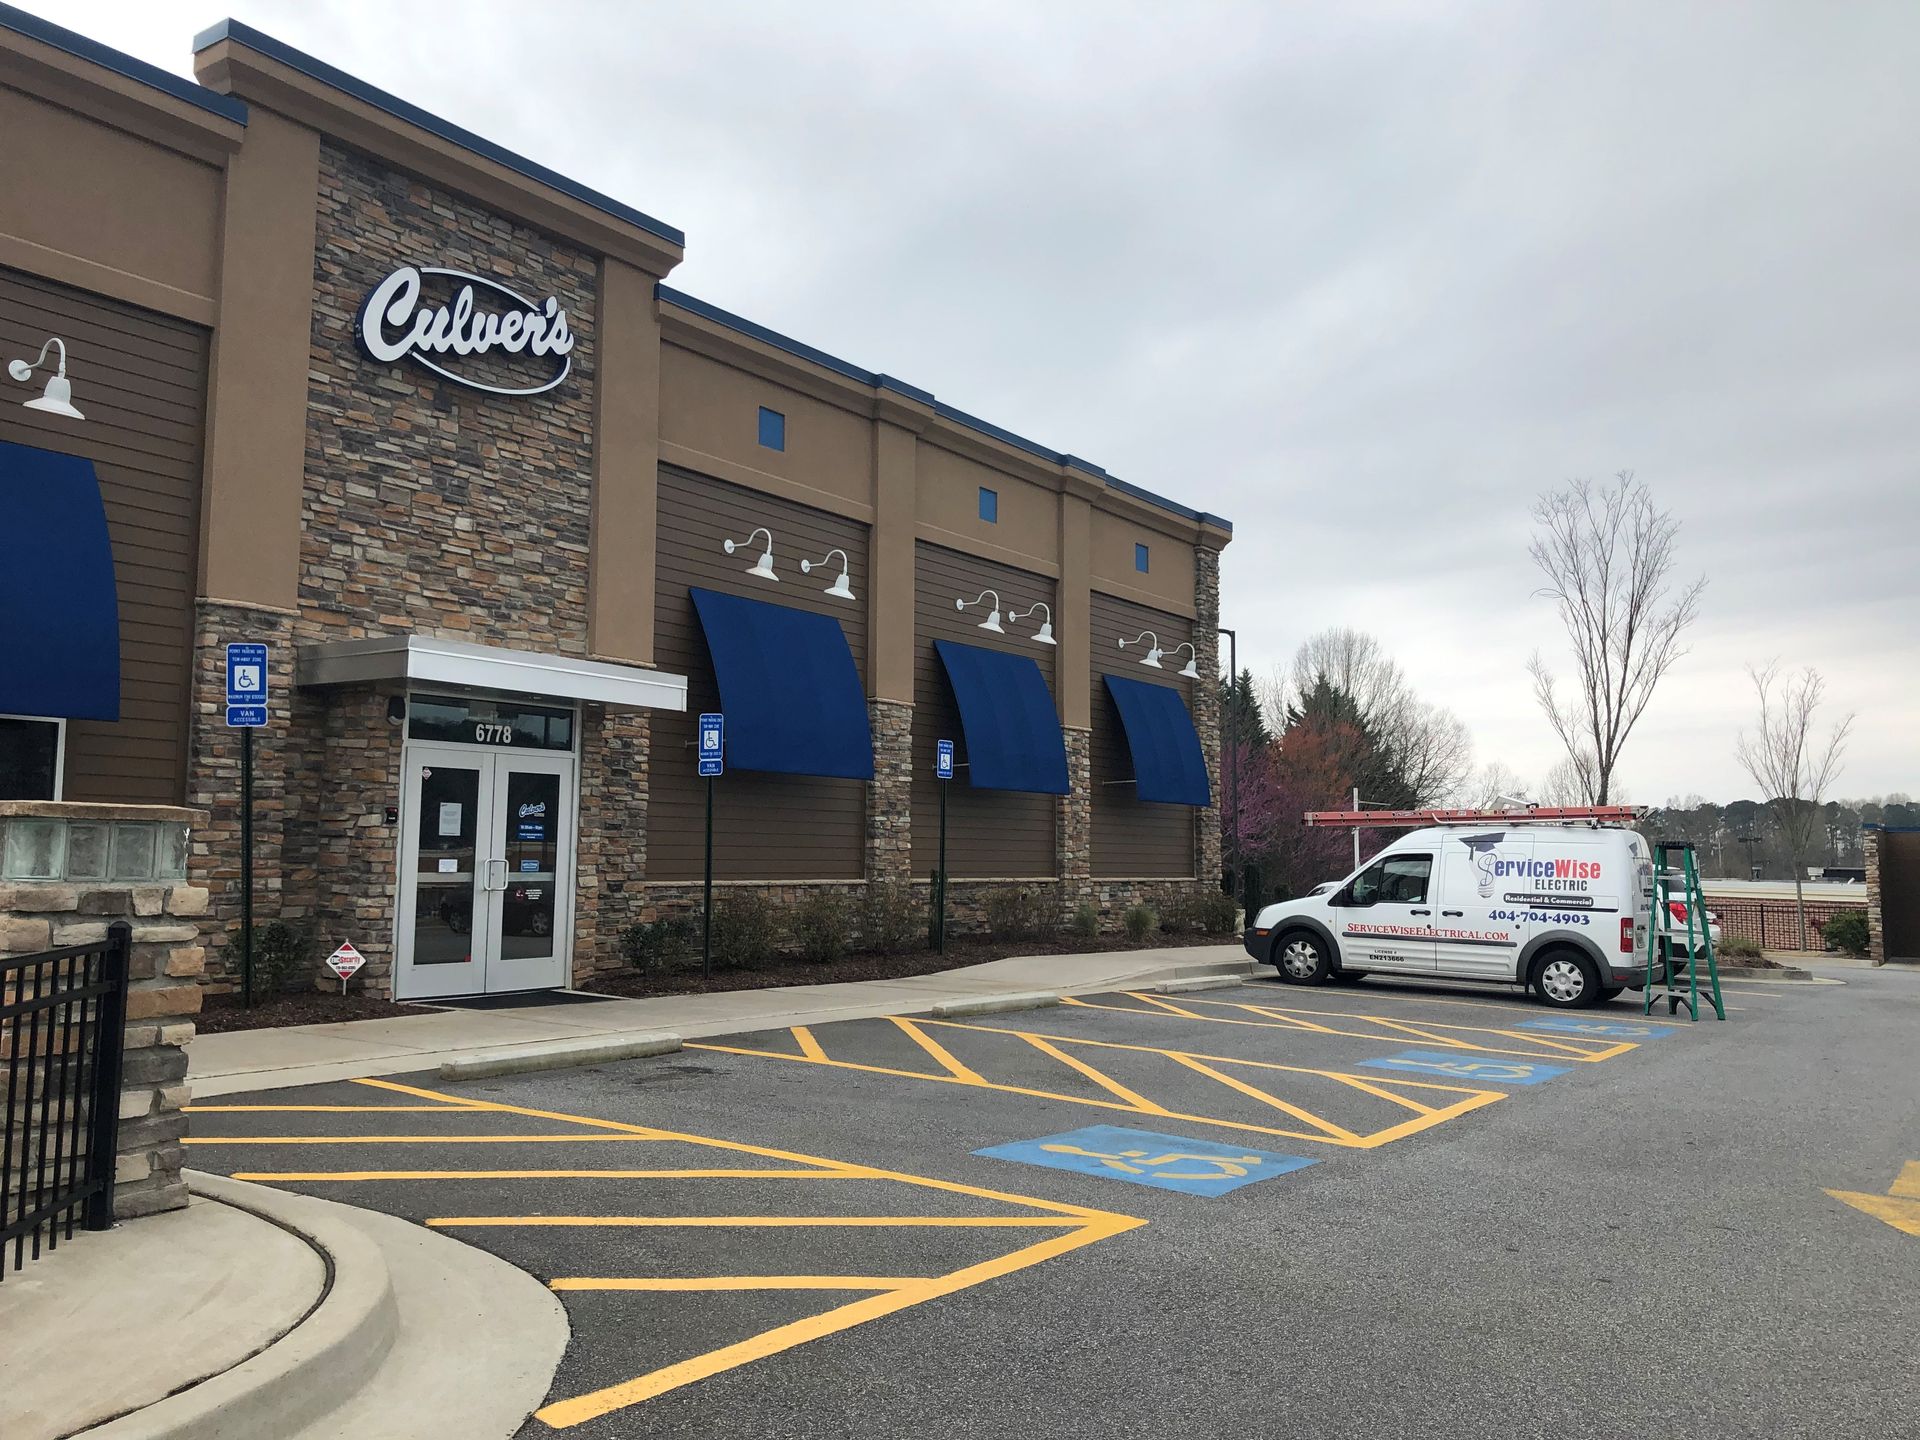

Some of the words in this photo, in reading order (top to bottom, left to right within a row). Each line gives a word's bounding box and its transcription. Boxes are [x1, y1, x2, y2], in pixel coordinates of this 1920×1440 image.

[363, 266, 575, 362] Culver's
[475, 723, 512, 744] 6778
[1534, 879, 1588, 891] ELECTRIC
[1505, 894, 1543, 903] Residential
[1544, 896, 1550, 904] &
[1550, 897, 1592, 906] Commercial
[1488, 910, 1591, 925] 404-704-4903
[1347, 922, 1509, 941] SERVICEWISEELECTRICAL.COM
